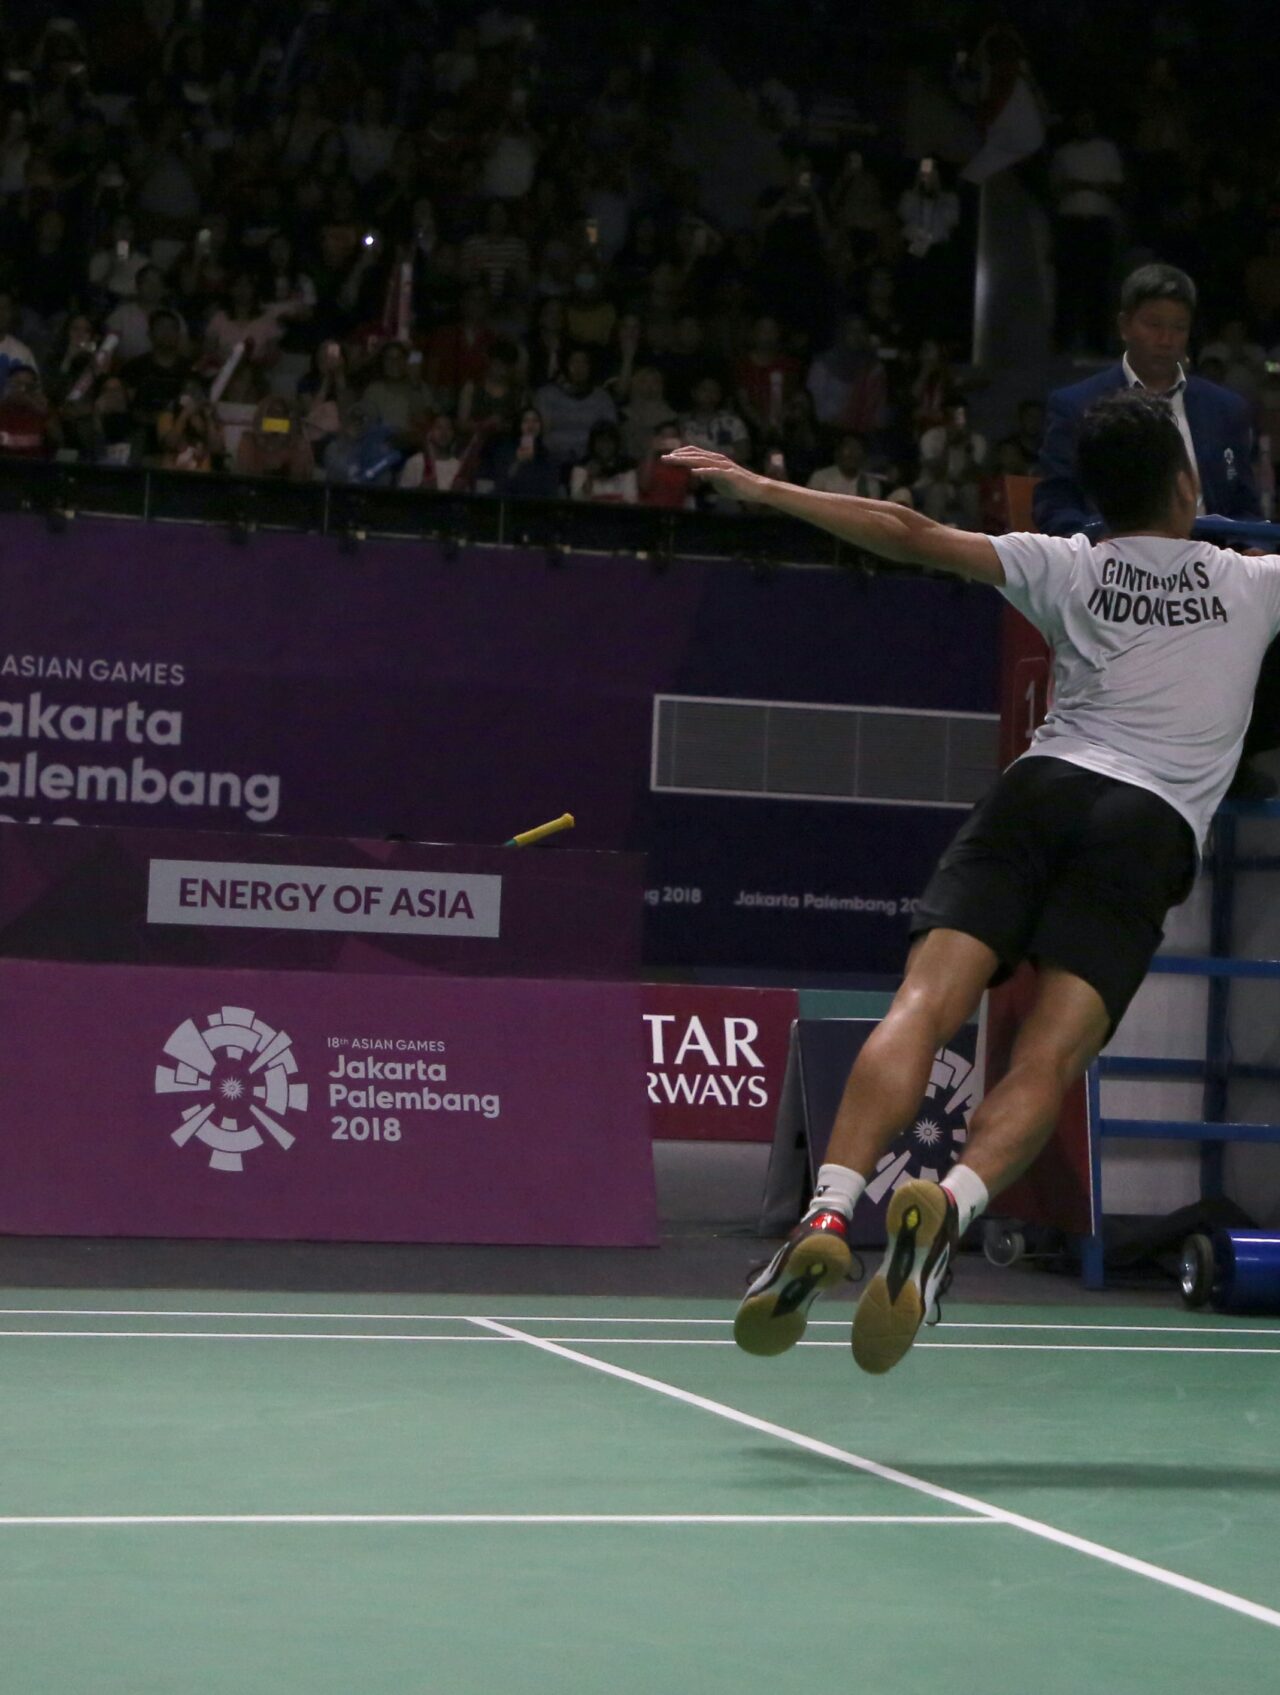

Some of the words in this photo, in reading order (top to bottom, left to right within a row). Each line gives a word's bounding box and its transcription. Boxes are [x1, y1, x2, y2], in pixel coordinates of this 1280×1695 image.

[1087, 588, 1228, 626] INDONESIA
[0, 654, 82, 680] ASIAN
[89, 659, 186, 686] GAMES
[0, 692, 183, 746] akarta
[0, 751, 281, 823] alembang
[179, 877, 326, 913] ENERGY
[333, 885, 383, 915] OF
[390, 887, 475, 919] ASIA
[662, 886, 702, 904] 2018
[734, 890, 800, 909] Jakarta
[803, 893, 897, 916] Palembang
[352, 1038, 393, 1050] ASIAN
[396, 1040, 446, 1052] GAMES
[642, 1014, 765, 1068] TAR
[328, 1054, 447, 1082] Jakarta
[329, 1083, 500, 1119] Palembang
[646, 1072, 768, 1107] RWAYS
[330, 1115, 402, 1142] 2018
